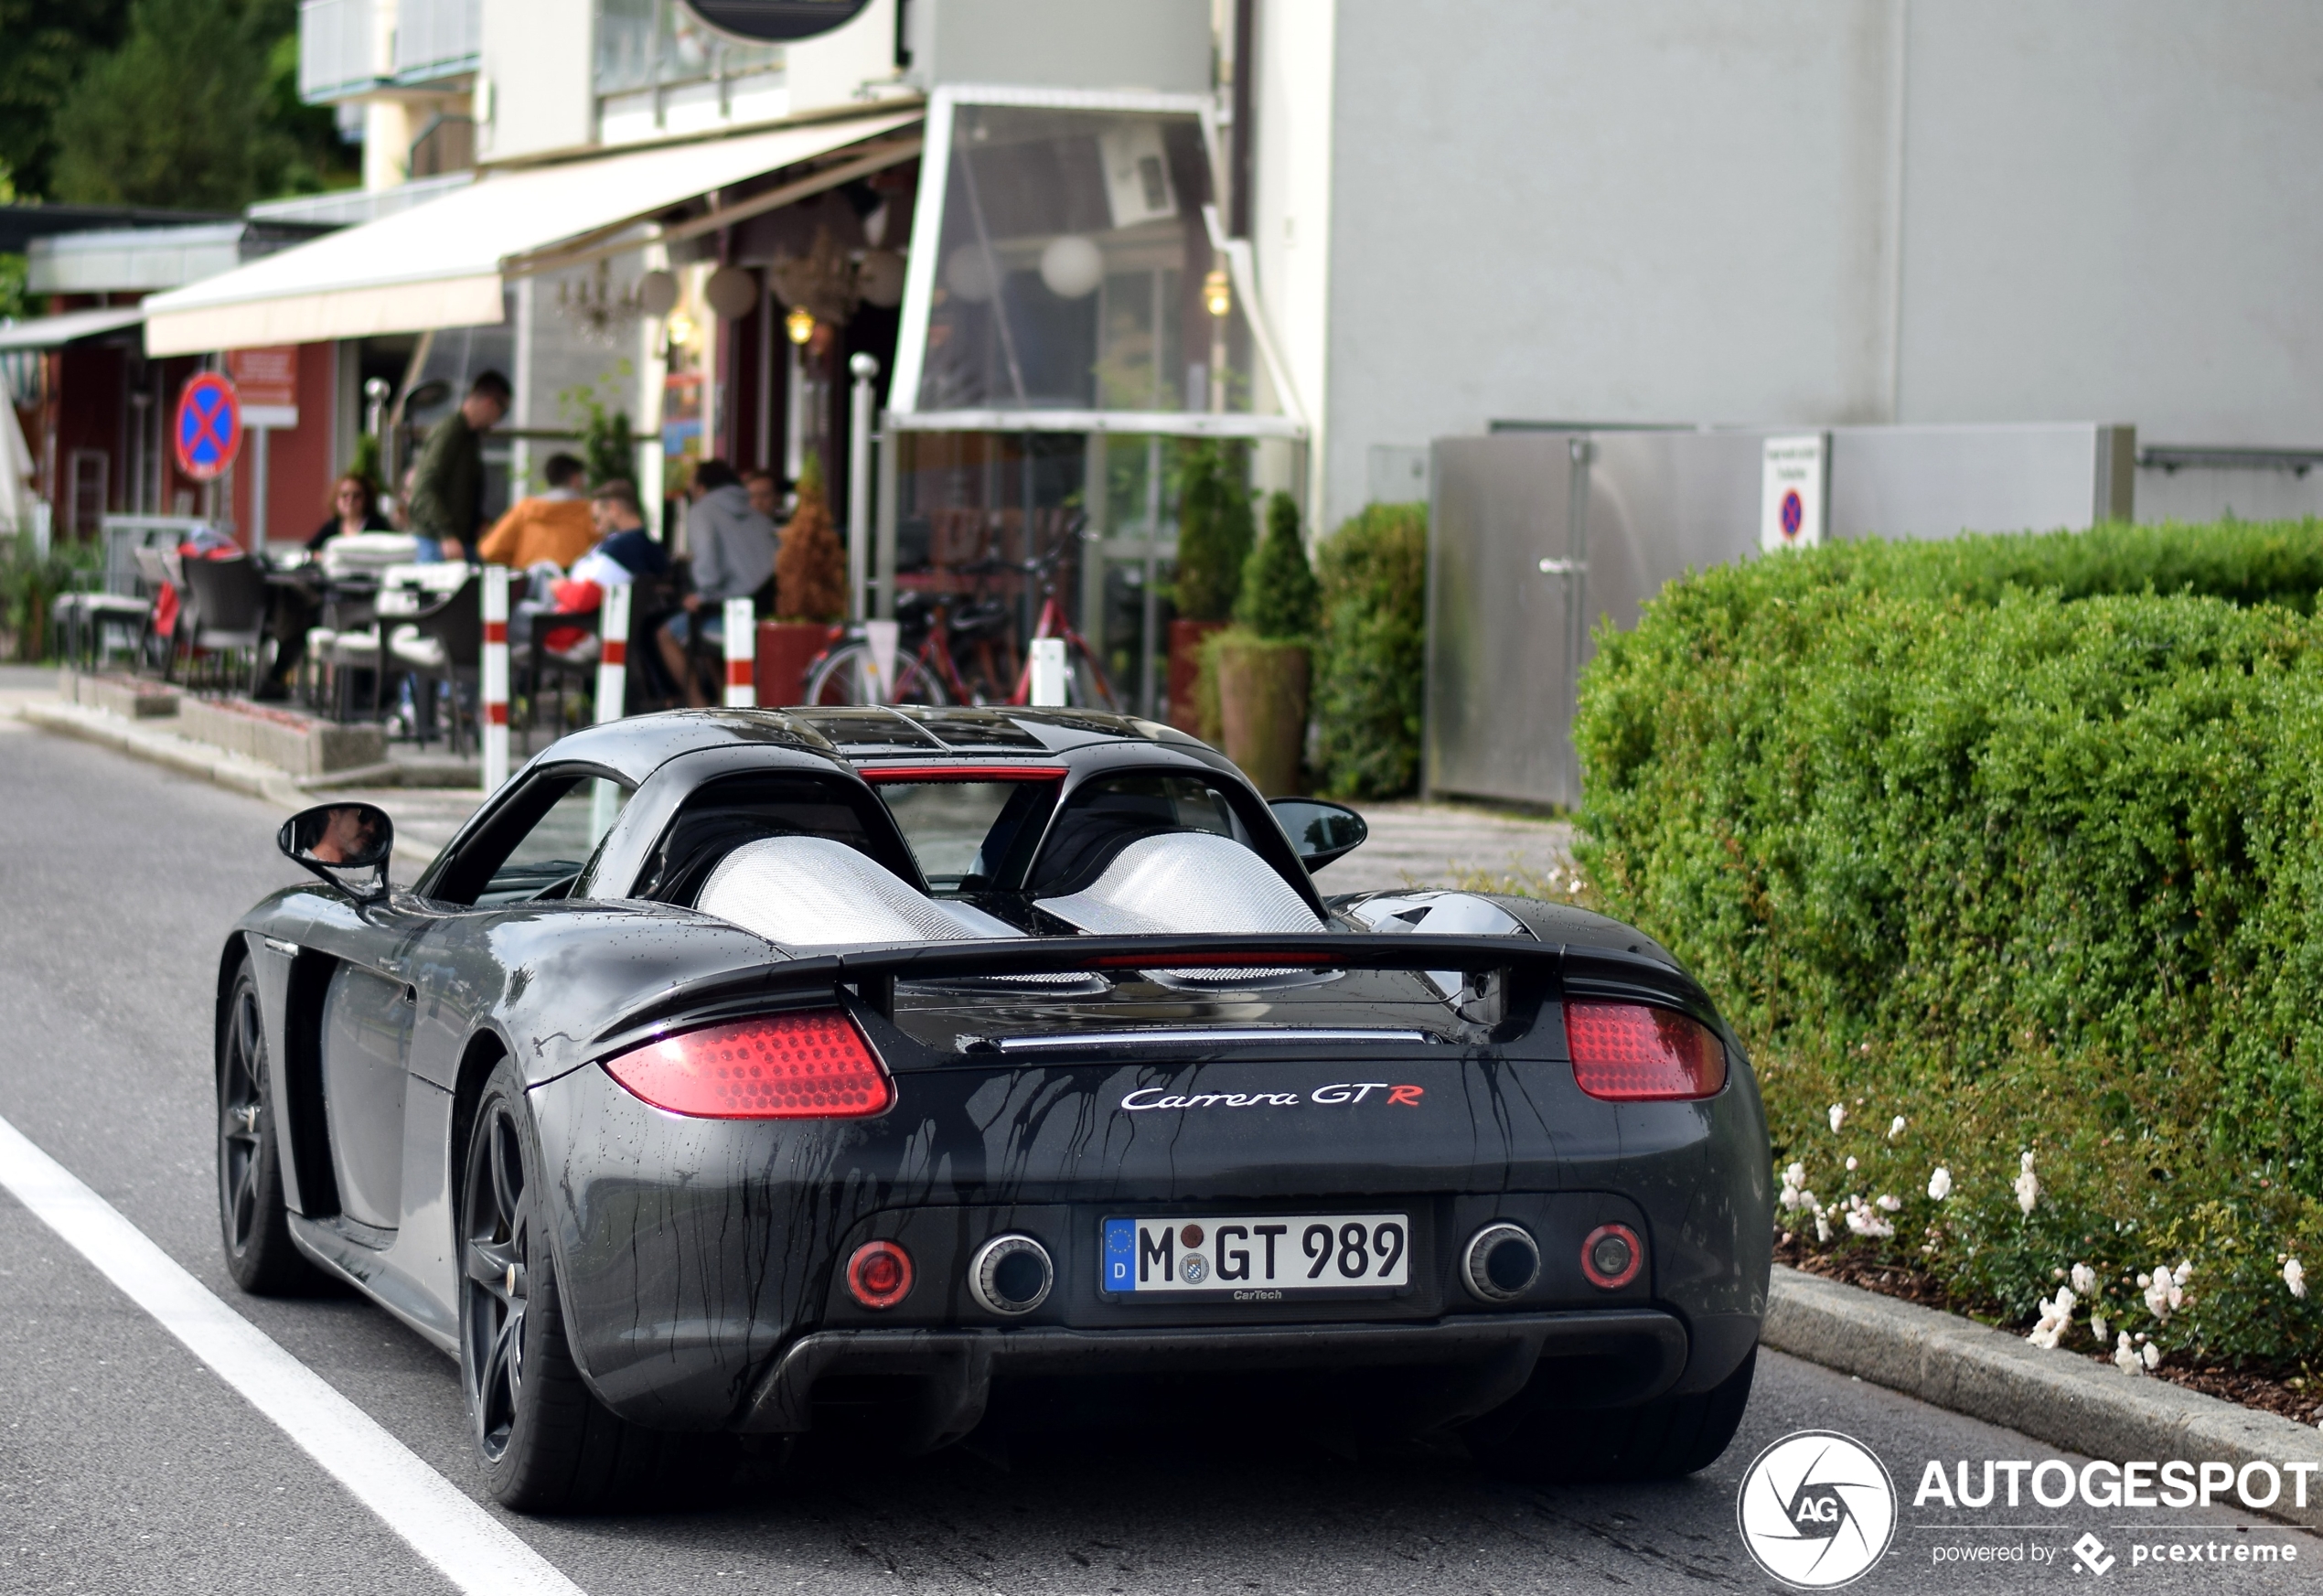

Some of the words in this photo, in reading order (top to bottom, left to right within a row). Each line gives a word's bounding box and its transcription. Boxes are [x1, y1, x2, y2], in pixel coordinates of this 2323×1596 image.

[1121, 1087, 1299, 1109] Carrera
[1140, 1226, 1174, 1281] M
[1215, 1225, 1287, 1280] GT
[1302, 1222, 1404, 1278] 989
[1114, 1263, 1126, 1278] D
[1234, 1290, 1282, 1300] CarTech
